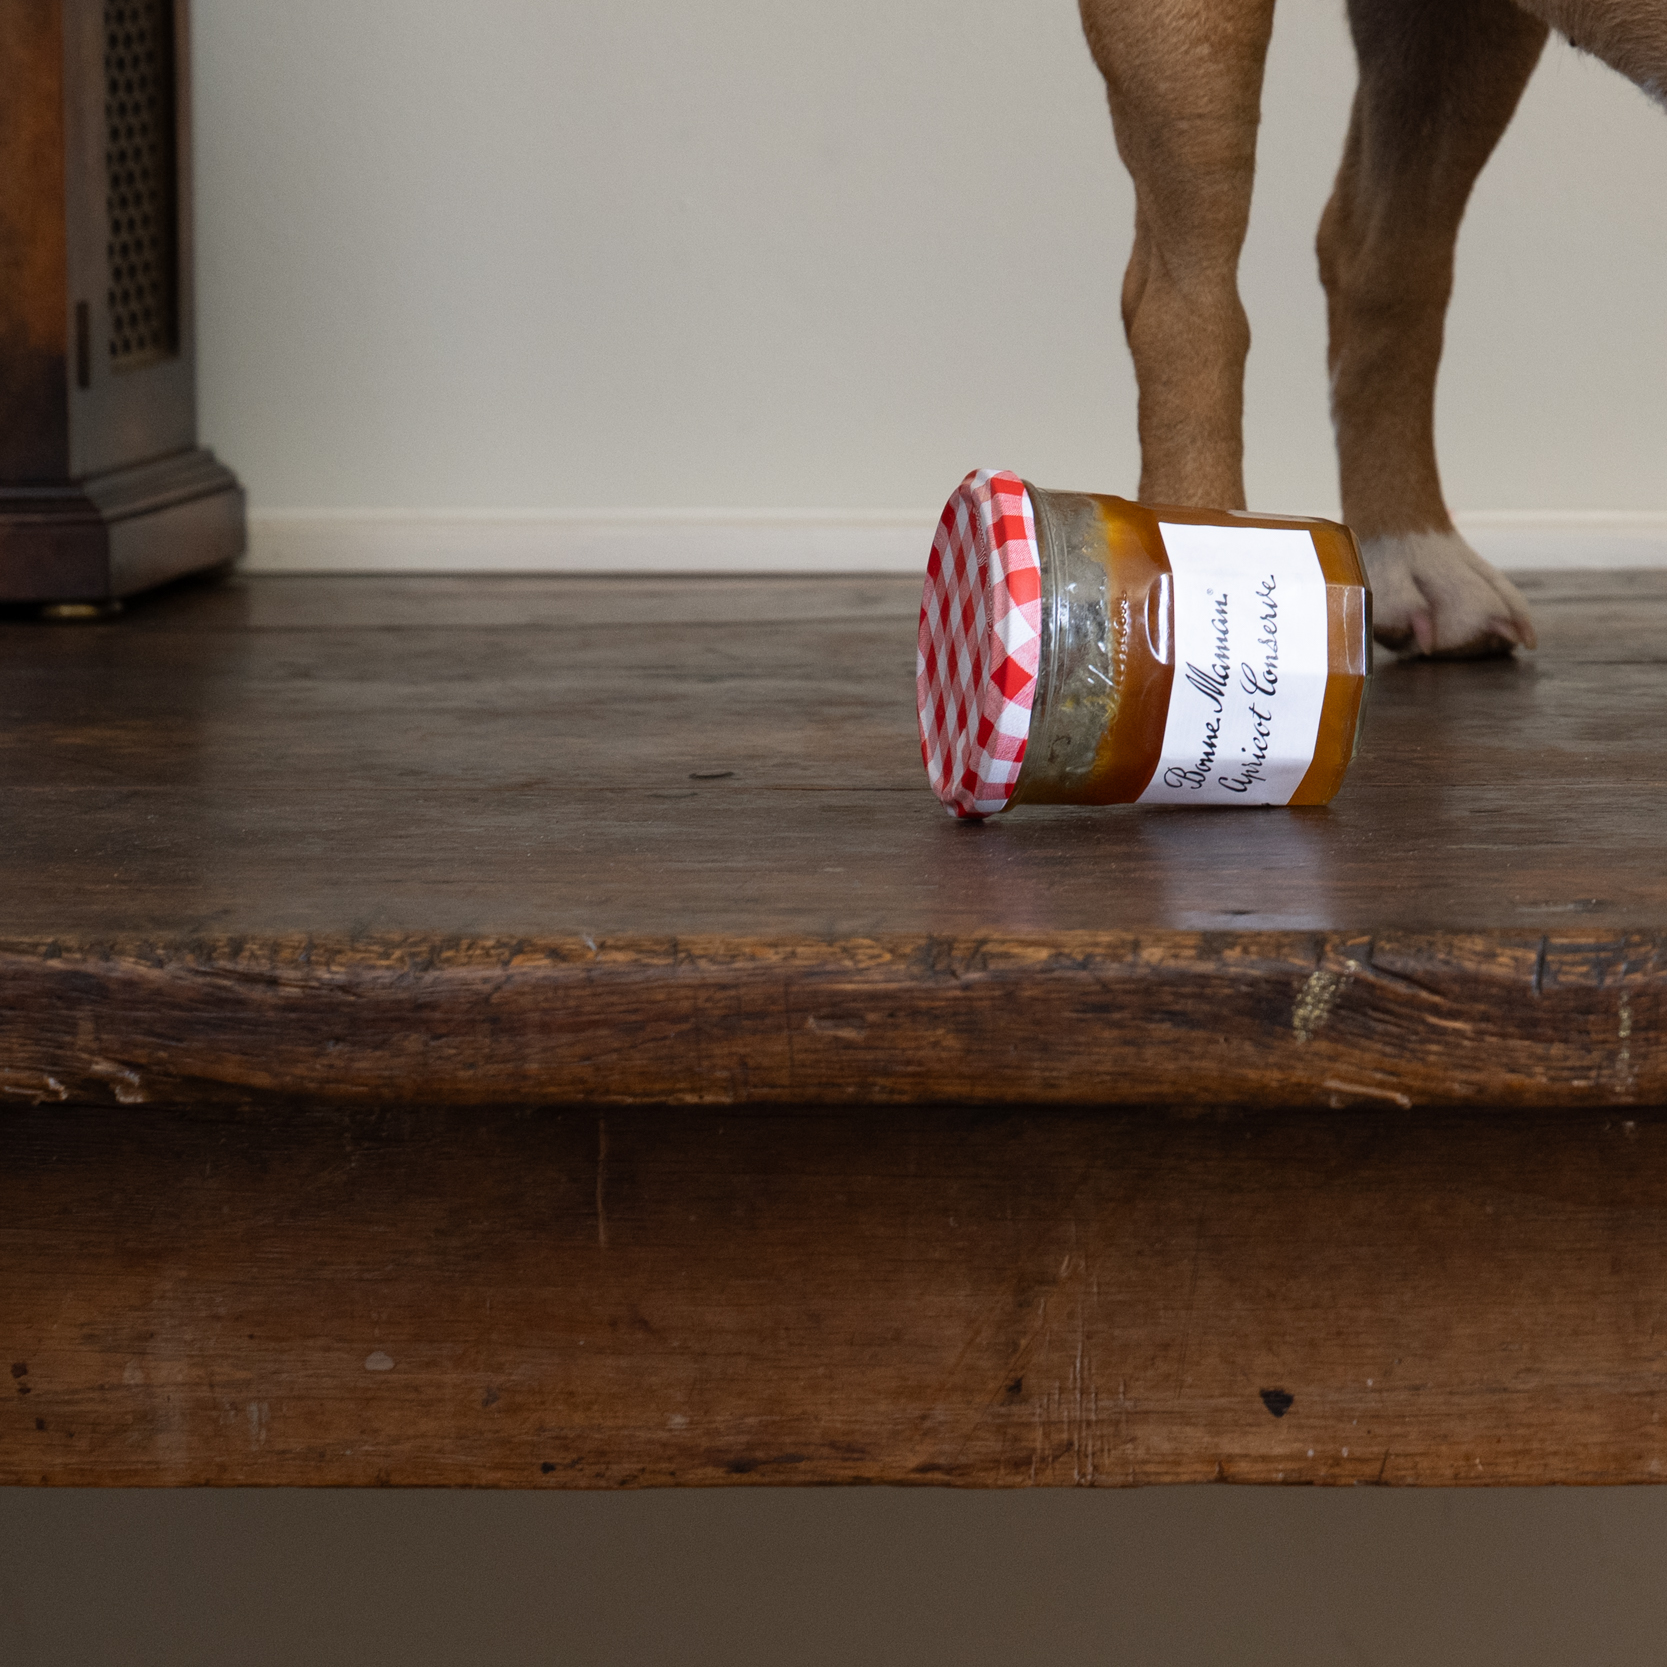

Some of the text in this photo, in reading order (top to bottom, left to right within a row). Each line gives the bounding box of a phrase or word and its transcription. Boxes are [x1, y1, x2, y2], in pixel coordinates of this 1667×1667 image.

[1164, 717, 1221, 789] Bonne
[1218, 574, 1278, 793] Apricot Conserve
